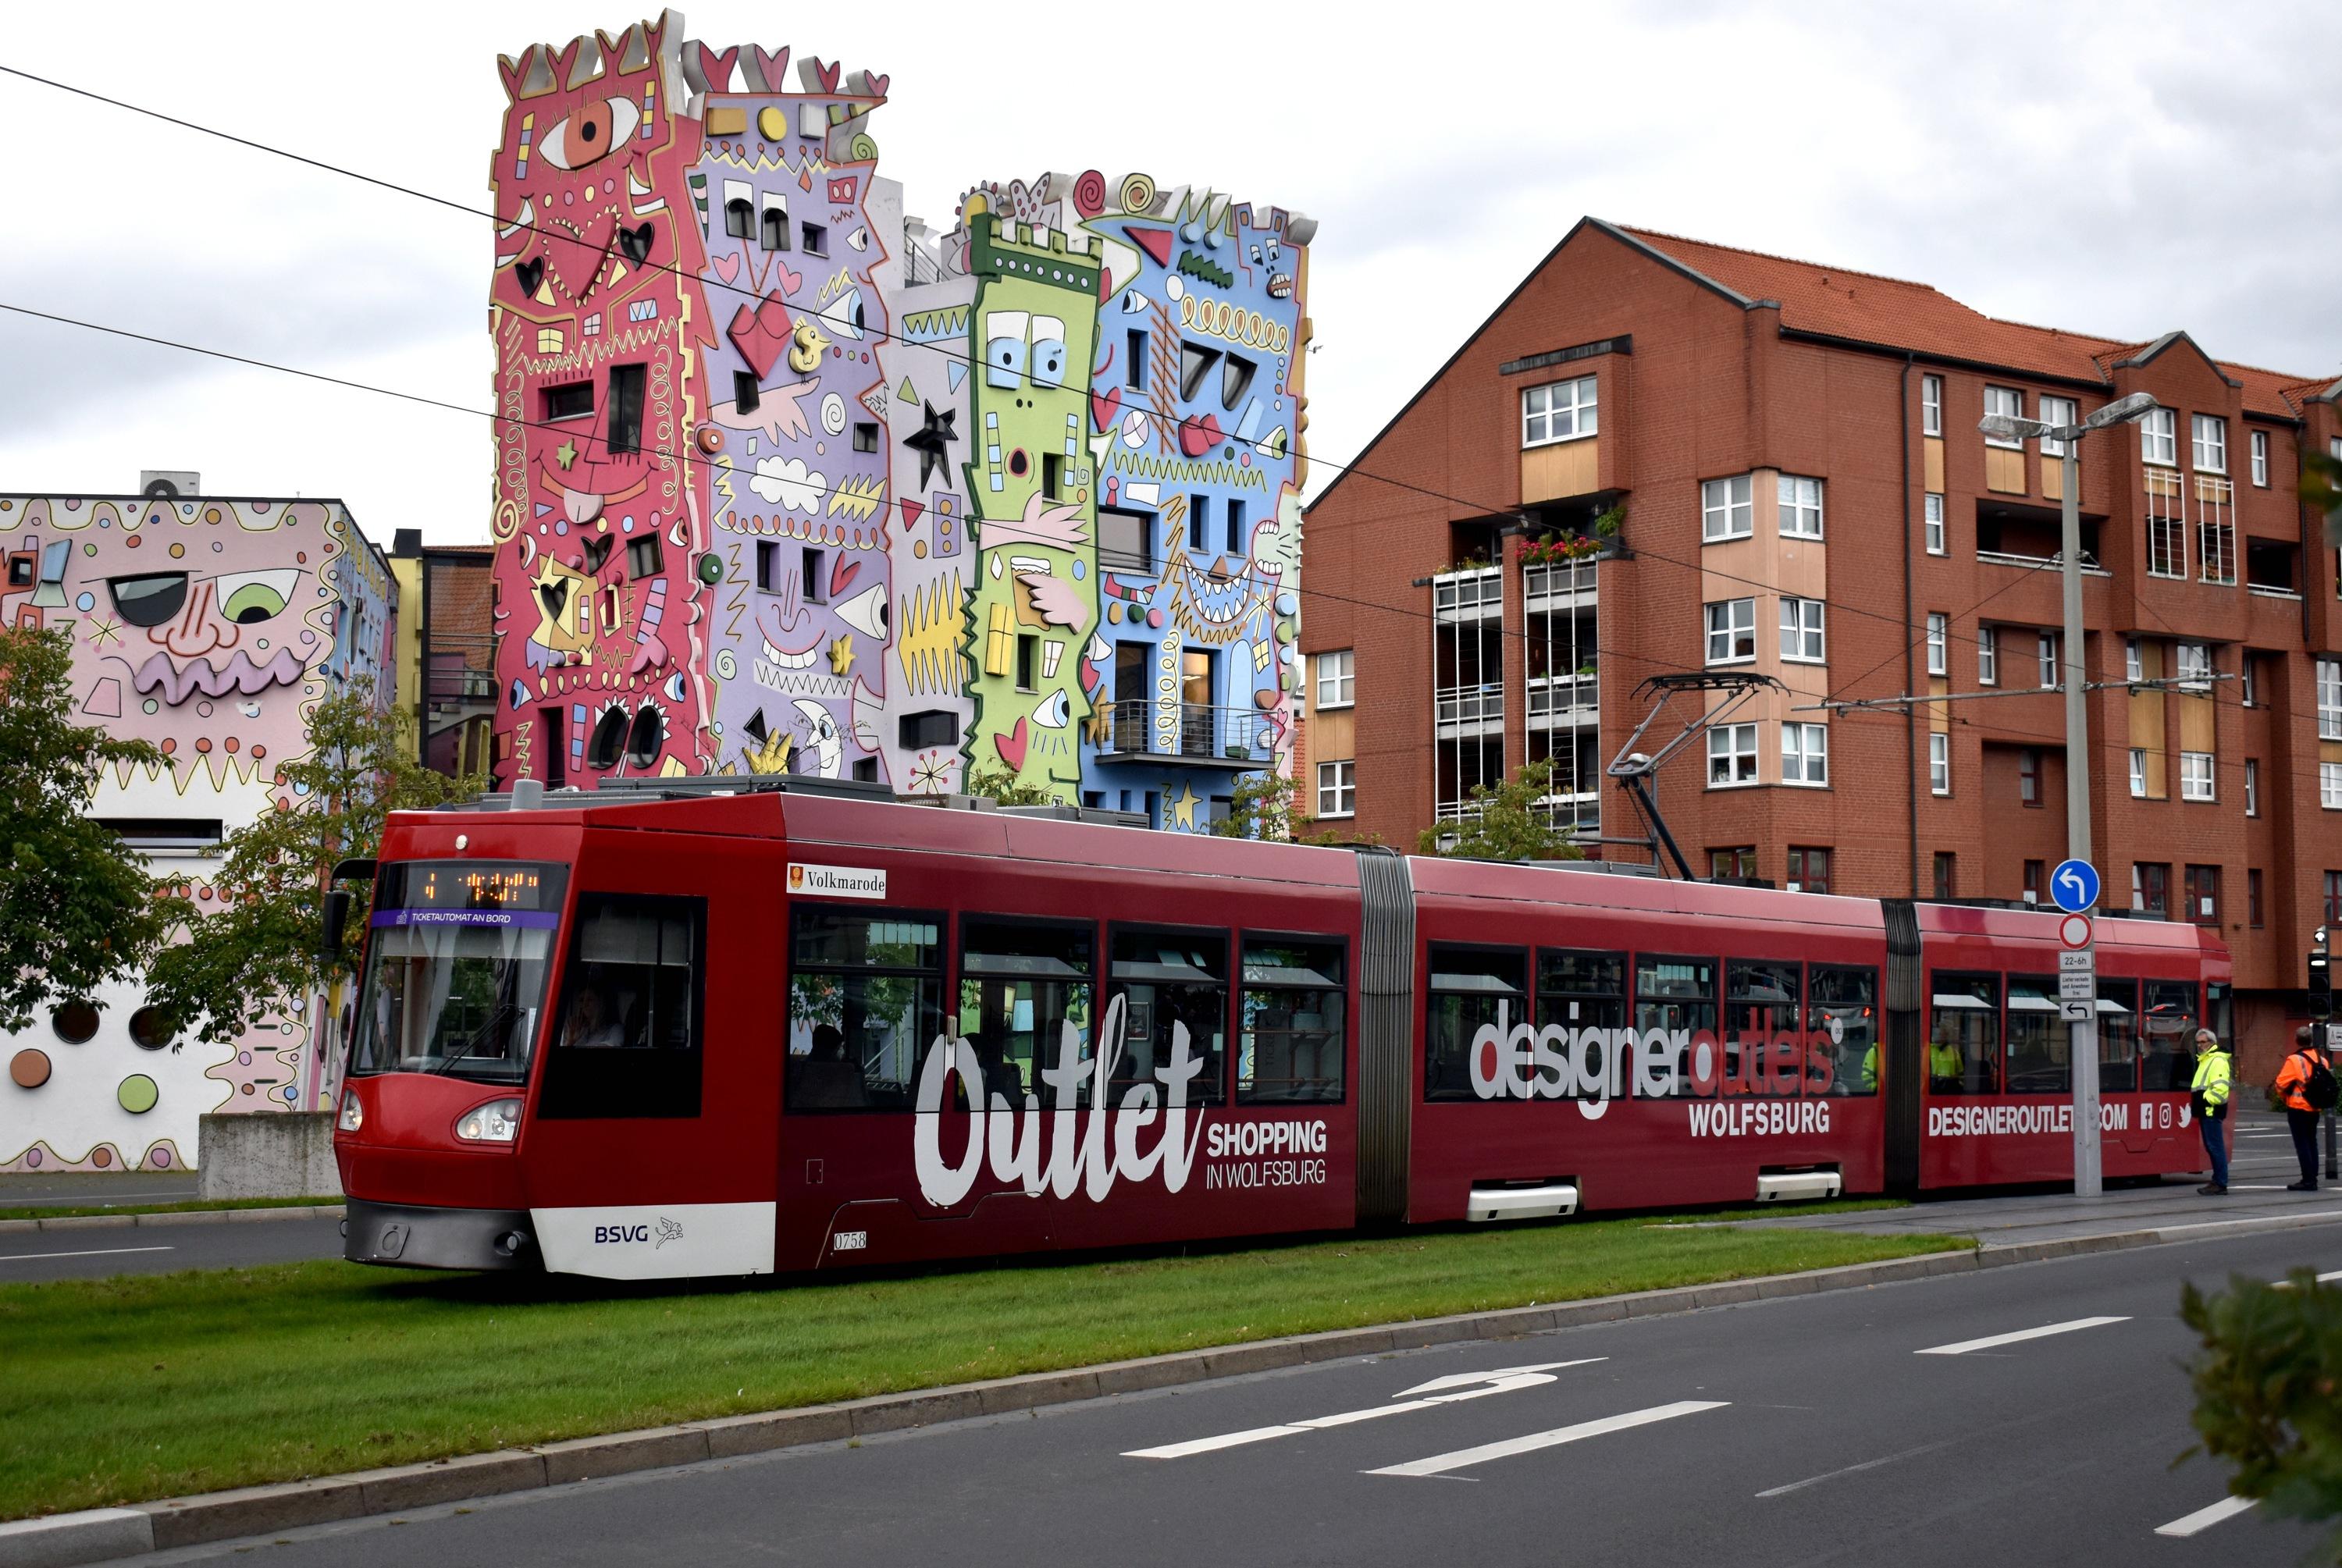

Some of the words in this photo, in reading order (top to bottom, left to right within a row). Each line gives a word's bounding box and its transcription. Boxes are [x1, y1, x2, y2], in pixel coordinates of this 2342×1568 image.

[807, 871, 885, 892] Volkmarode
[411, 912, 472, 922] TICKETAUTOMAT
[472, 913, 486, 922] AN
[486, 914, 511, 923] BORD
[2065, 957, 2087, 965] 22-6h
[913, 992, 1205, 1208] Outlet
[1688, 1101, 1830, 1137] WOLFSBURG
[1206, 1119, 1326, 1157] SHOPPING
[1206, 1164, 1223, 1189] IN
[1226, 1158, 1326, 1189] WOLFSBURG
[595, 1225, 648, 1243] BSVG
[835, 1232, 866, 1249] 0758
